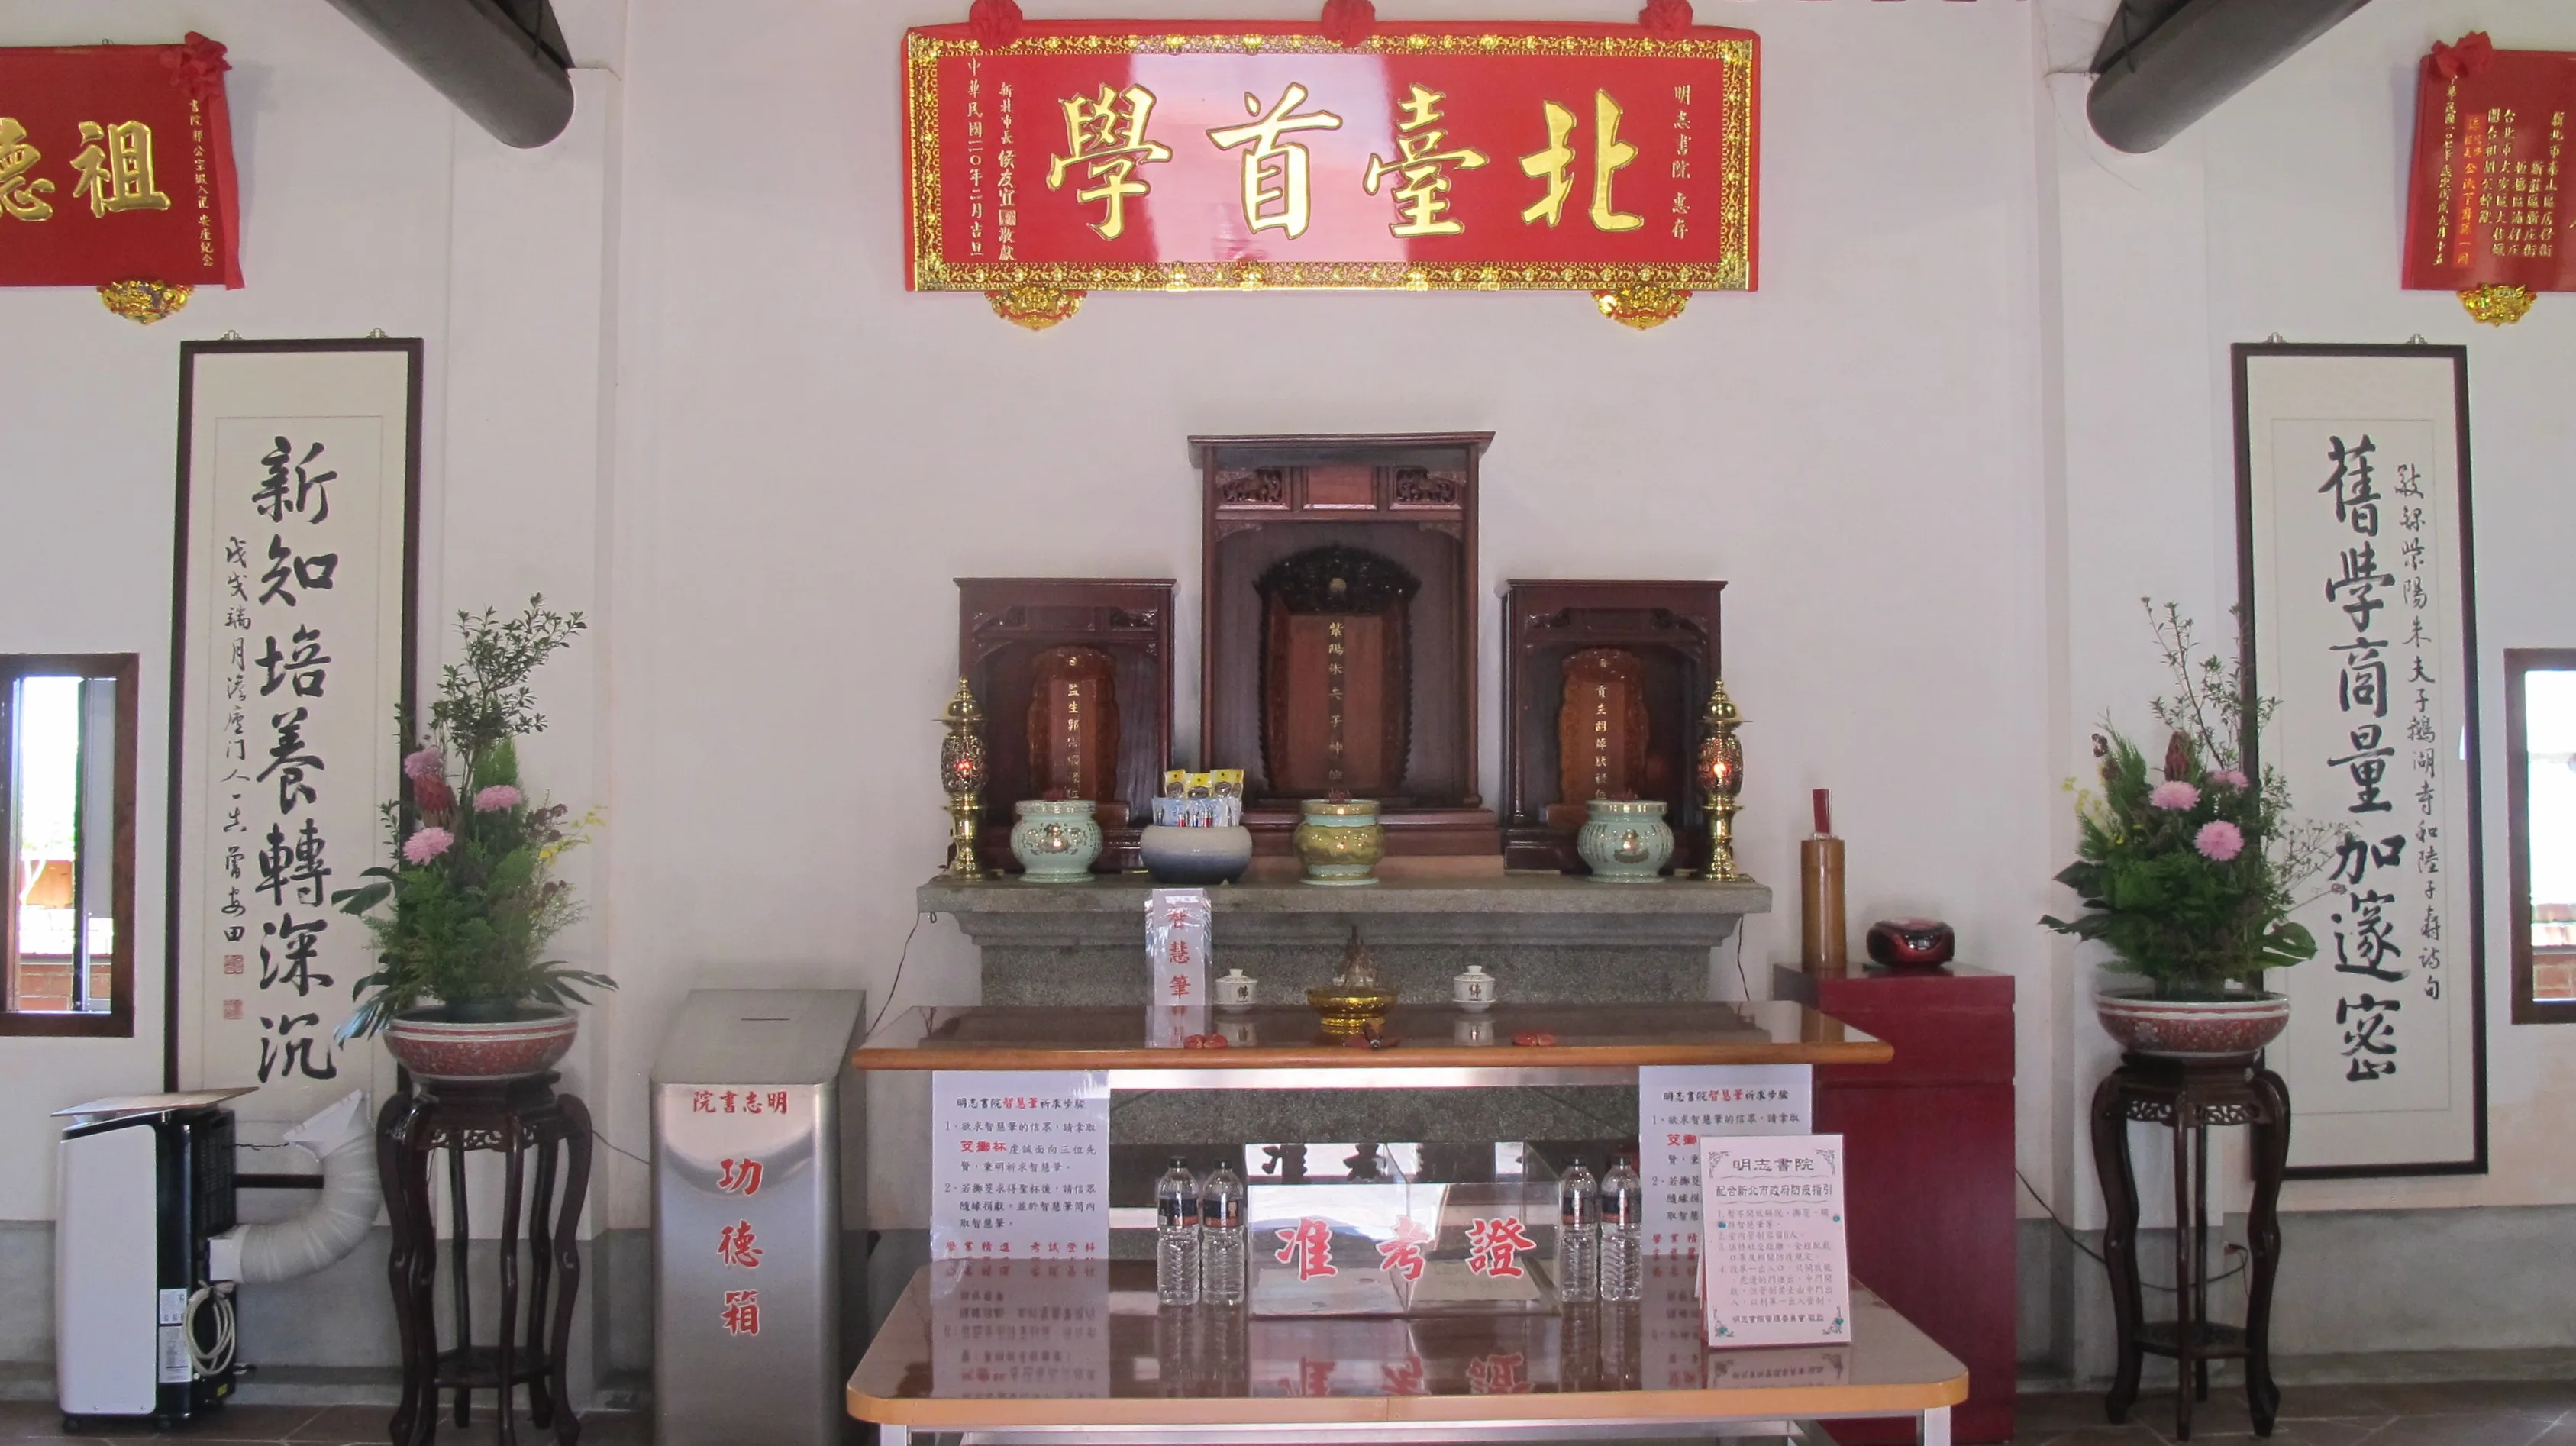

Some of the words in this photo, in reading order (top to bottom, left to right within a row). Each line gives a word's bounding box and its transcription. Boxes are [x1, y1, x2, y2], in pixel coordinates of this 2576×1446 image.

[1045, 82, 1645, 240] 北臺首學
[254, 435, 339, 1084] 新知培養轉深沉
[2318, 433, 2410, 1082] 舊學商量加邃密
[692, 1090, 789, 1115] 明志書院
[1732, 1157, 1815, 1172] 明志書院
[715, 1157, 764, 1336] 功德箱
[1274, 1214, 1538, 1282] 准考證
